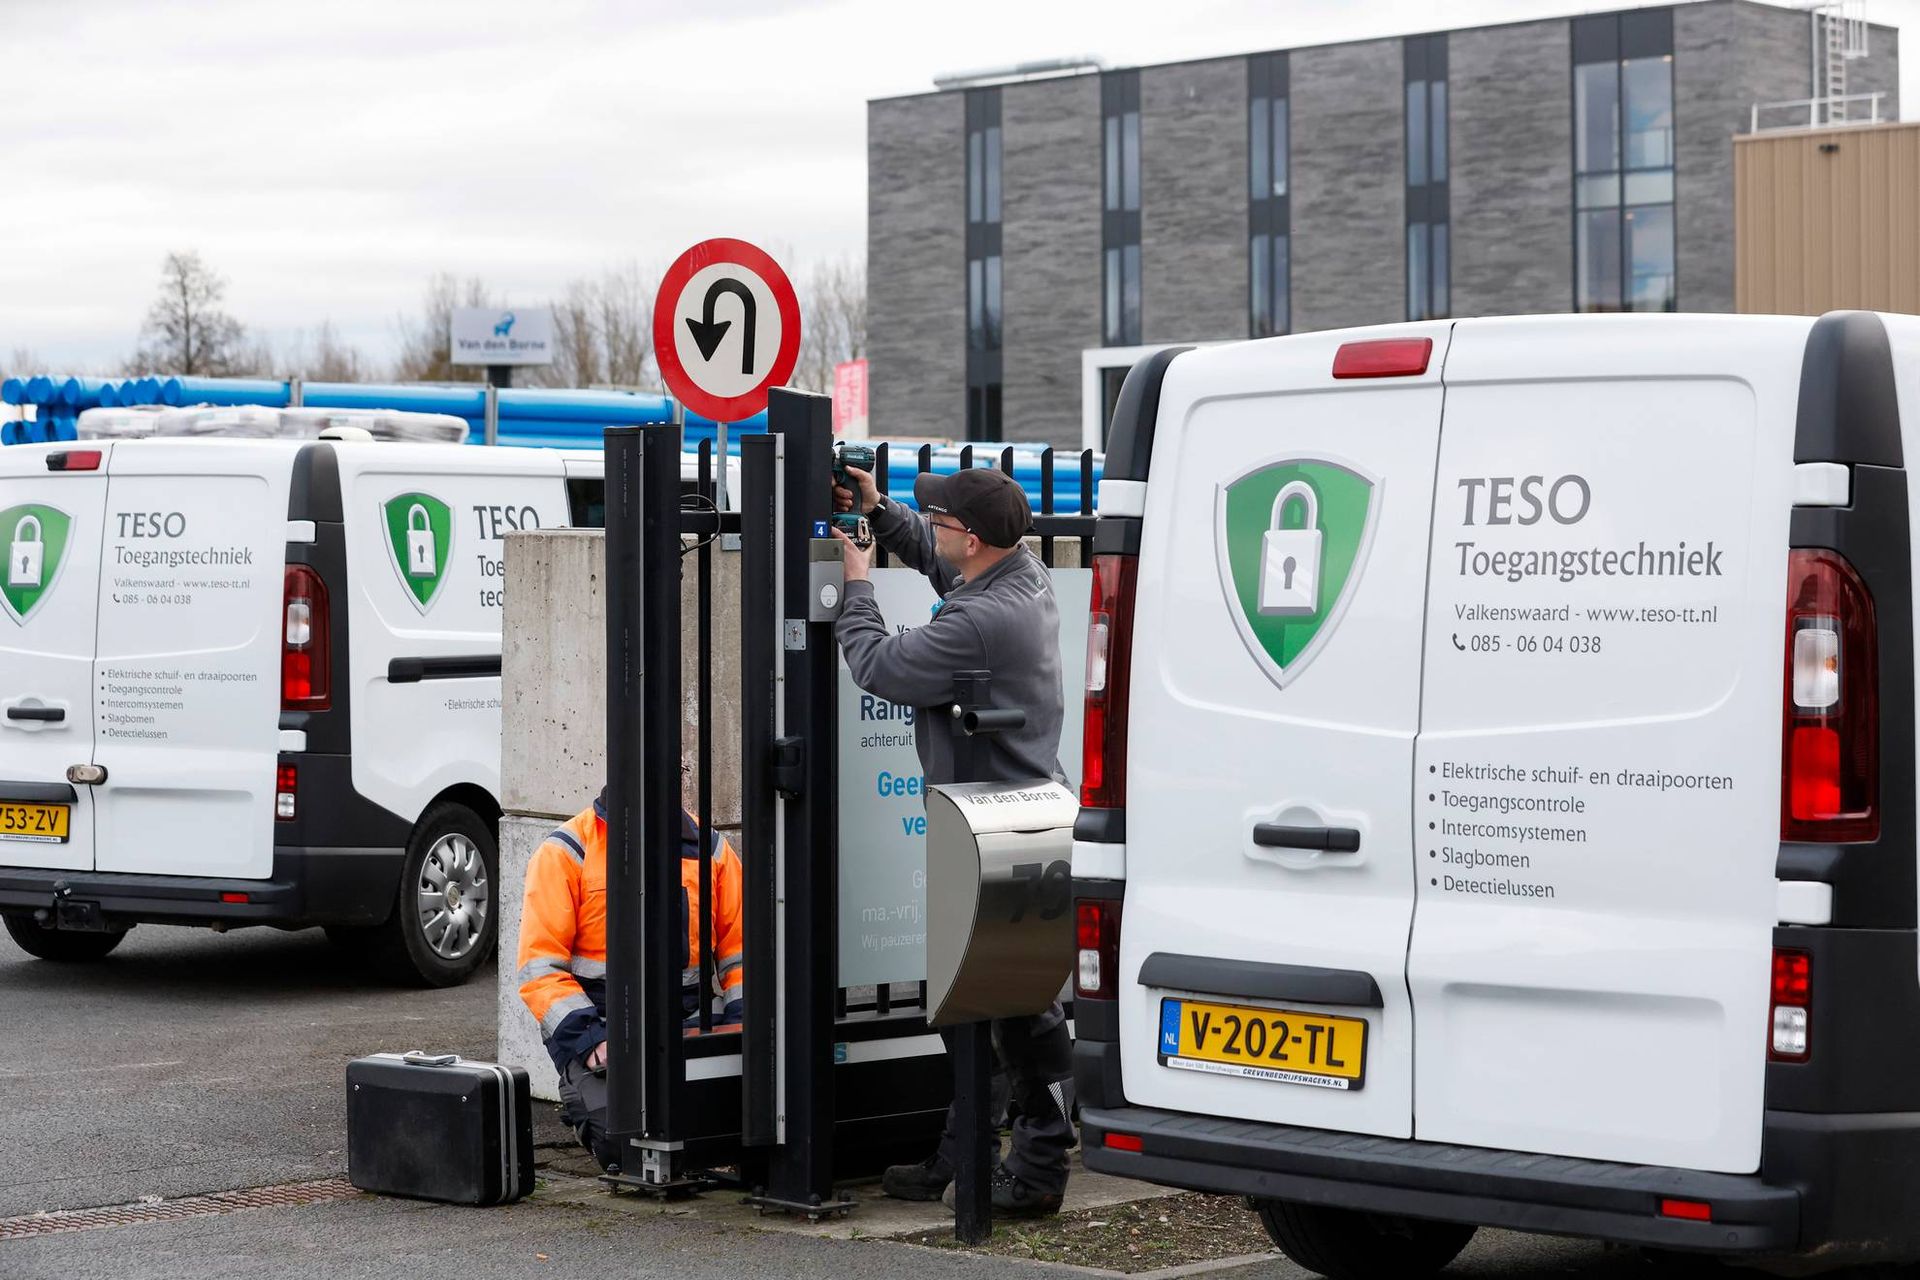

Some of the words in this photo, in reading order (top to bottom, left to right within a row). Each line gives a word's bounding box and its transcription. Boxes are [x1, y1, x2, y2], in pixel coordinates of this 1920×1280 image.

[484, 340, 506, 350] den
[1458, 475, 1591, 526] TESO
[117, 512, 186, 538] TESO
[473, 505, 540, 539] TESO
[818, 526, 824, 536] 4
[115, 546, 252, 568] Toegangstechniek
[1455, 541, 1723, 582] Toegangstechniek
[114, 577, 175, 589] Valkenswaard
[183, 578, 250, 590] www.teso-tt.nl
[123, 592, 138, 605] 085
[146, 593, 158, 605] 06
[160, 593, 172, 605] 04
[174, 592, 192, 605] 038
[1455, 604, 1569, 621] Valkenswaard
[1587, 606, 1717, 622] www.teso-tt.nl
[1471, 635, 1500, 652] 085
[1517, 636, 1537, 652] 06
[1543, 636, 1563, 652] 04
[1570, 636, 1600, 653] 038
[108, 669, 153, 681] Elektrische
[154, 670, 181, 682] schuif-
[184, 672, 195, 681] en
[198, 671, 258, 684] draaipoorten
[108, 684, 183, 697] Toegangscontrole
[108, 699, 183, 712] Intercomsystemen
[448, 699, 486, 710] Elektrische
[860, 695, 914, 726] Rang
[107, 714, 155, 726] Slagbomen
[108, 728, 168, 741] Detectielussen
[861, 731, 913, 748] achteruit
[1443, 762, 1526, 781] Elektrische
[1531, 766, 1583, 783] schuif-
[1590, 772, 1609, 784] en
[1617, 769, 1732, 791] draaipoorten
[962, 792, 992, 805] Van
[993, 792, 1019, 803] den
[1018, 790, 1061, 802] Borne
[1442, 791, 1585, 814] Toegangscontrole
[0, 808, 60, 831] 53-ZV
[1443, 819, 1586, 843] Intercomsystemen
[1442, 847, 1529, 869] Slagbomen
[1010, 860, 1071, 923] 79
[1444, 875, 1554, 898] Detectielussen
[862, 900, 922, 924] ma.-vrij.
[861, 934, 878, 951] Wij
[1165, 1032, 1177, 1046] NL
[1192, 1011, 1344, 1068] V-202-TL
